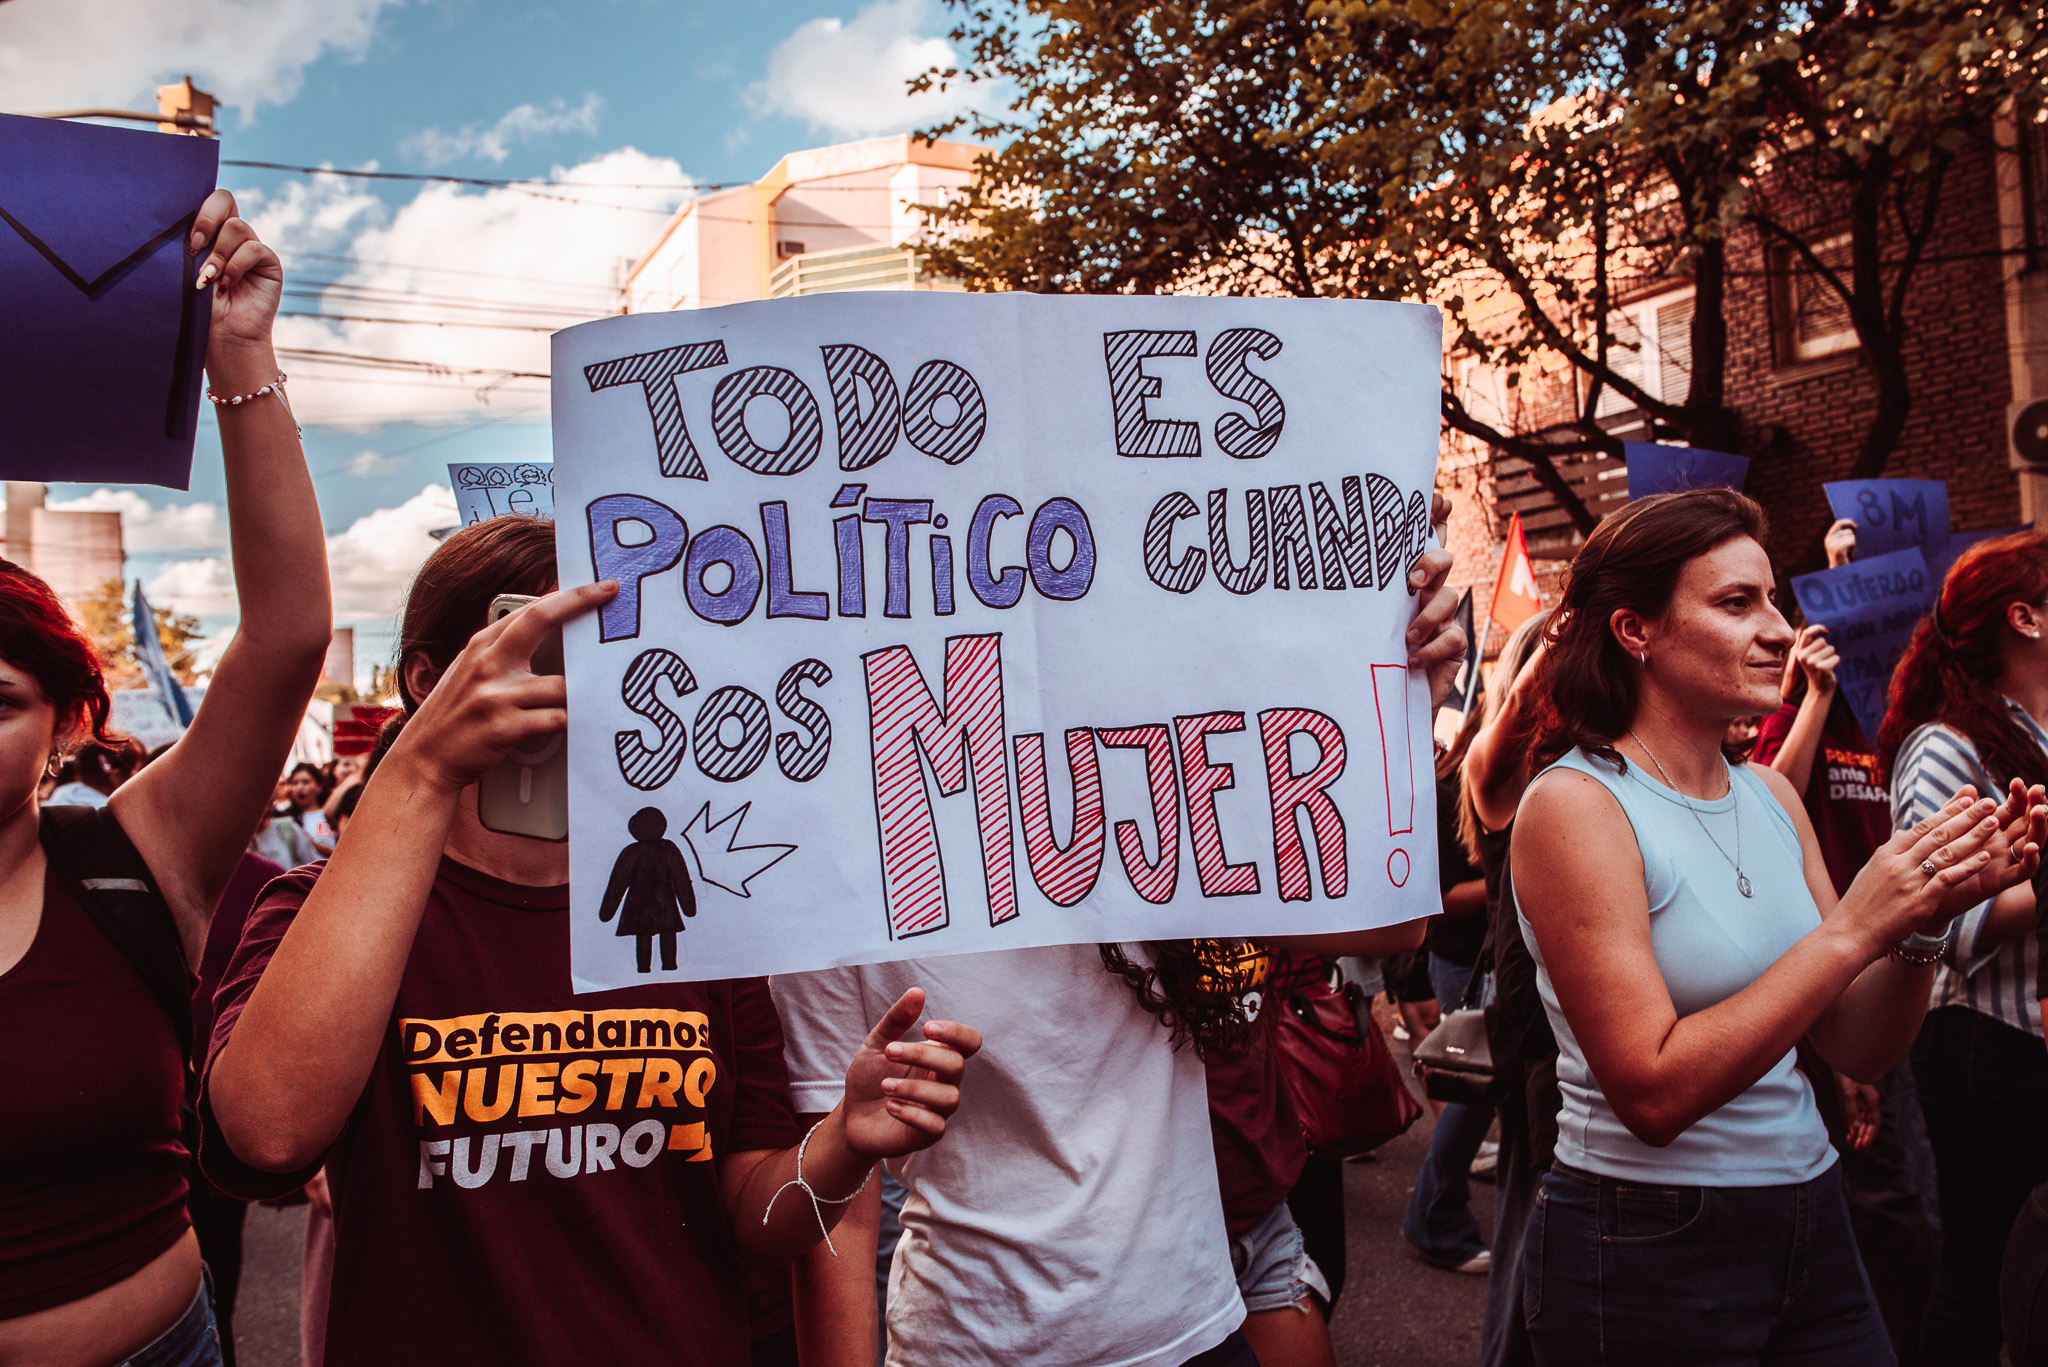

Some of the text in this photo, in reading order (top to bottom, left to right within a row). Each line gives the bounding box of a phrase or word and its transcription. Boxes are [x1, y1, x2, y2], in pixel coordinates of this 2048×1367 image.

[584, 327, 1286, 482] TODO ES
[1143, 473, 1427, 597] CUANDO
[1856, 489, 1928, 536] 8M
[616, 648, 832, 791] SOS
[405, 1013, 710, 1062] Defendamos
[410, 1057, 717, 1127] NUESTRO
[418, 1119, 666, 1189] FUTURO
